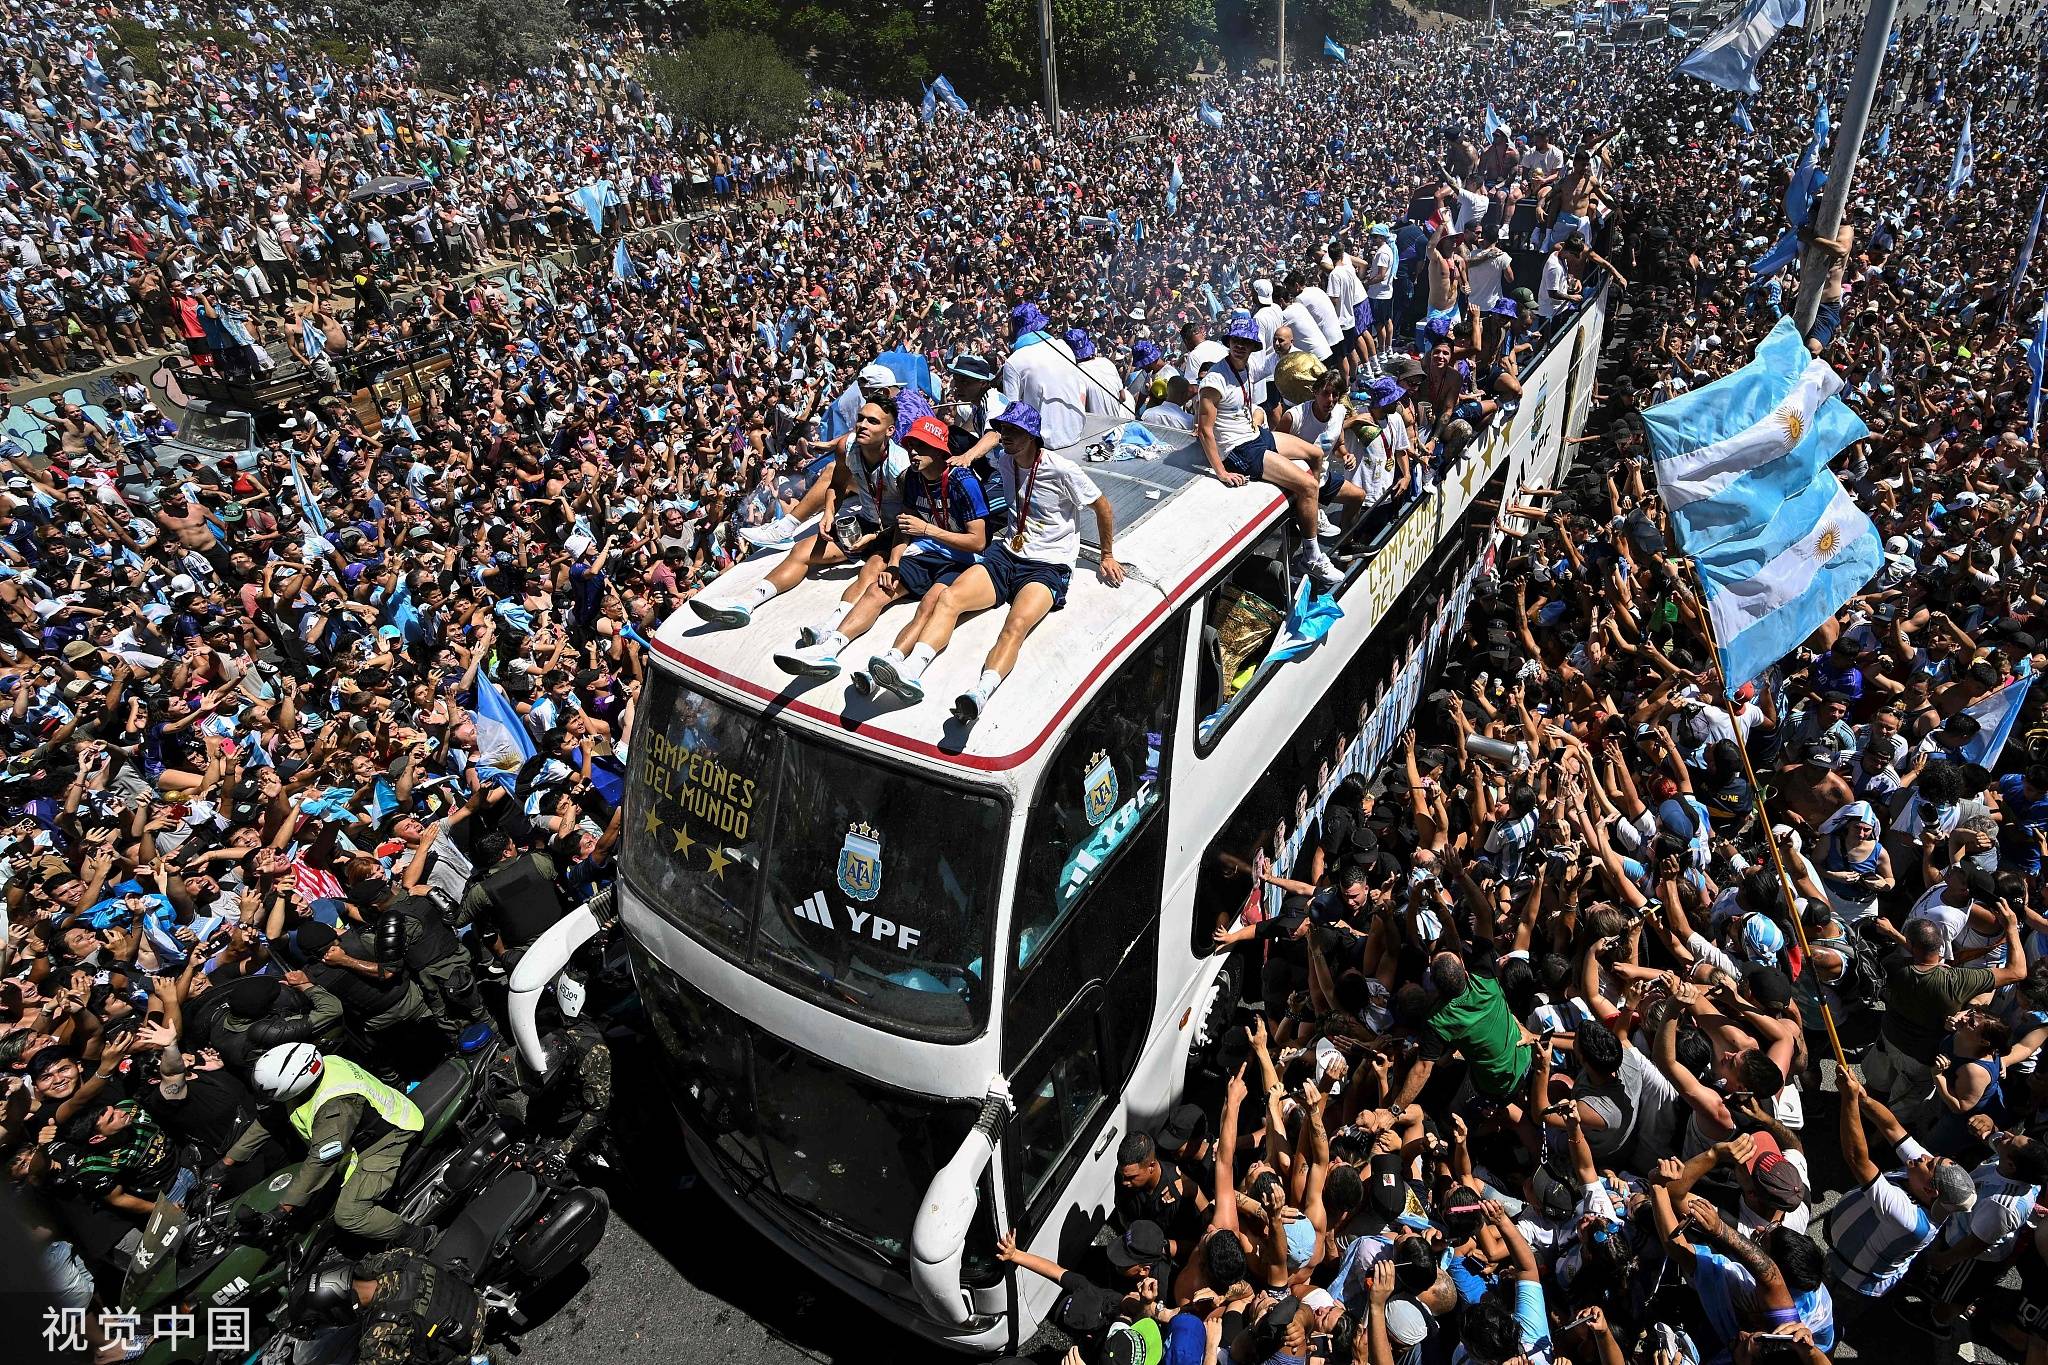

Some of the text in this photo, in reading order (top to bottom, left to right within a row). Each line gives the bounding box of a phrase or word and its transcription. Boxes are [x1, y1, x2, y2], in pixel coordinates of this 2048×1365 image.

[923, 421, 942, 438] RIVER
[1531, 424, 1551, 466] YPF
[1371, 574, 1396, 628] DEL
[644, 727, 756, 809] CAMPEONES
[644, 759, 749, 840] DEL MUNDO
[1100, 779, 1151, 842] YPF
[846, 854, 871, 887] AFA
[845, 905, 921, 950] YPF
[211, 1276, 250, 1306] GNA
